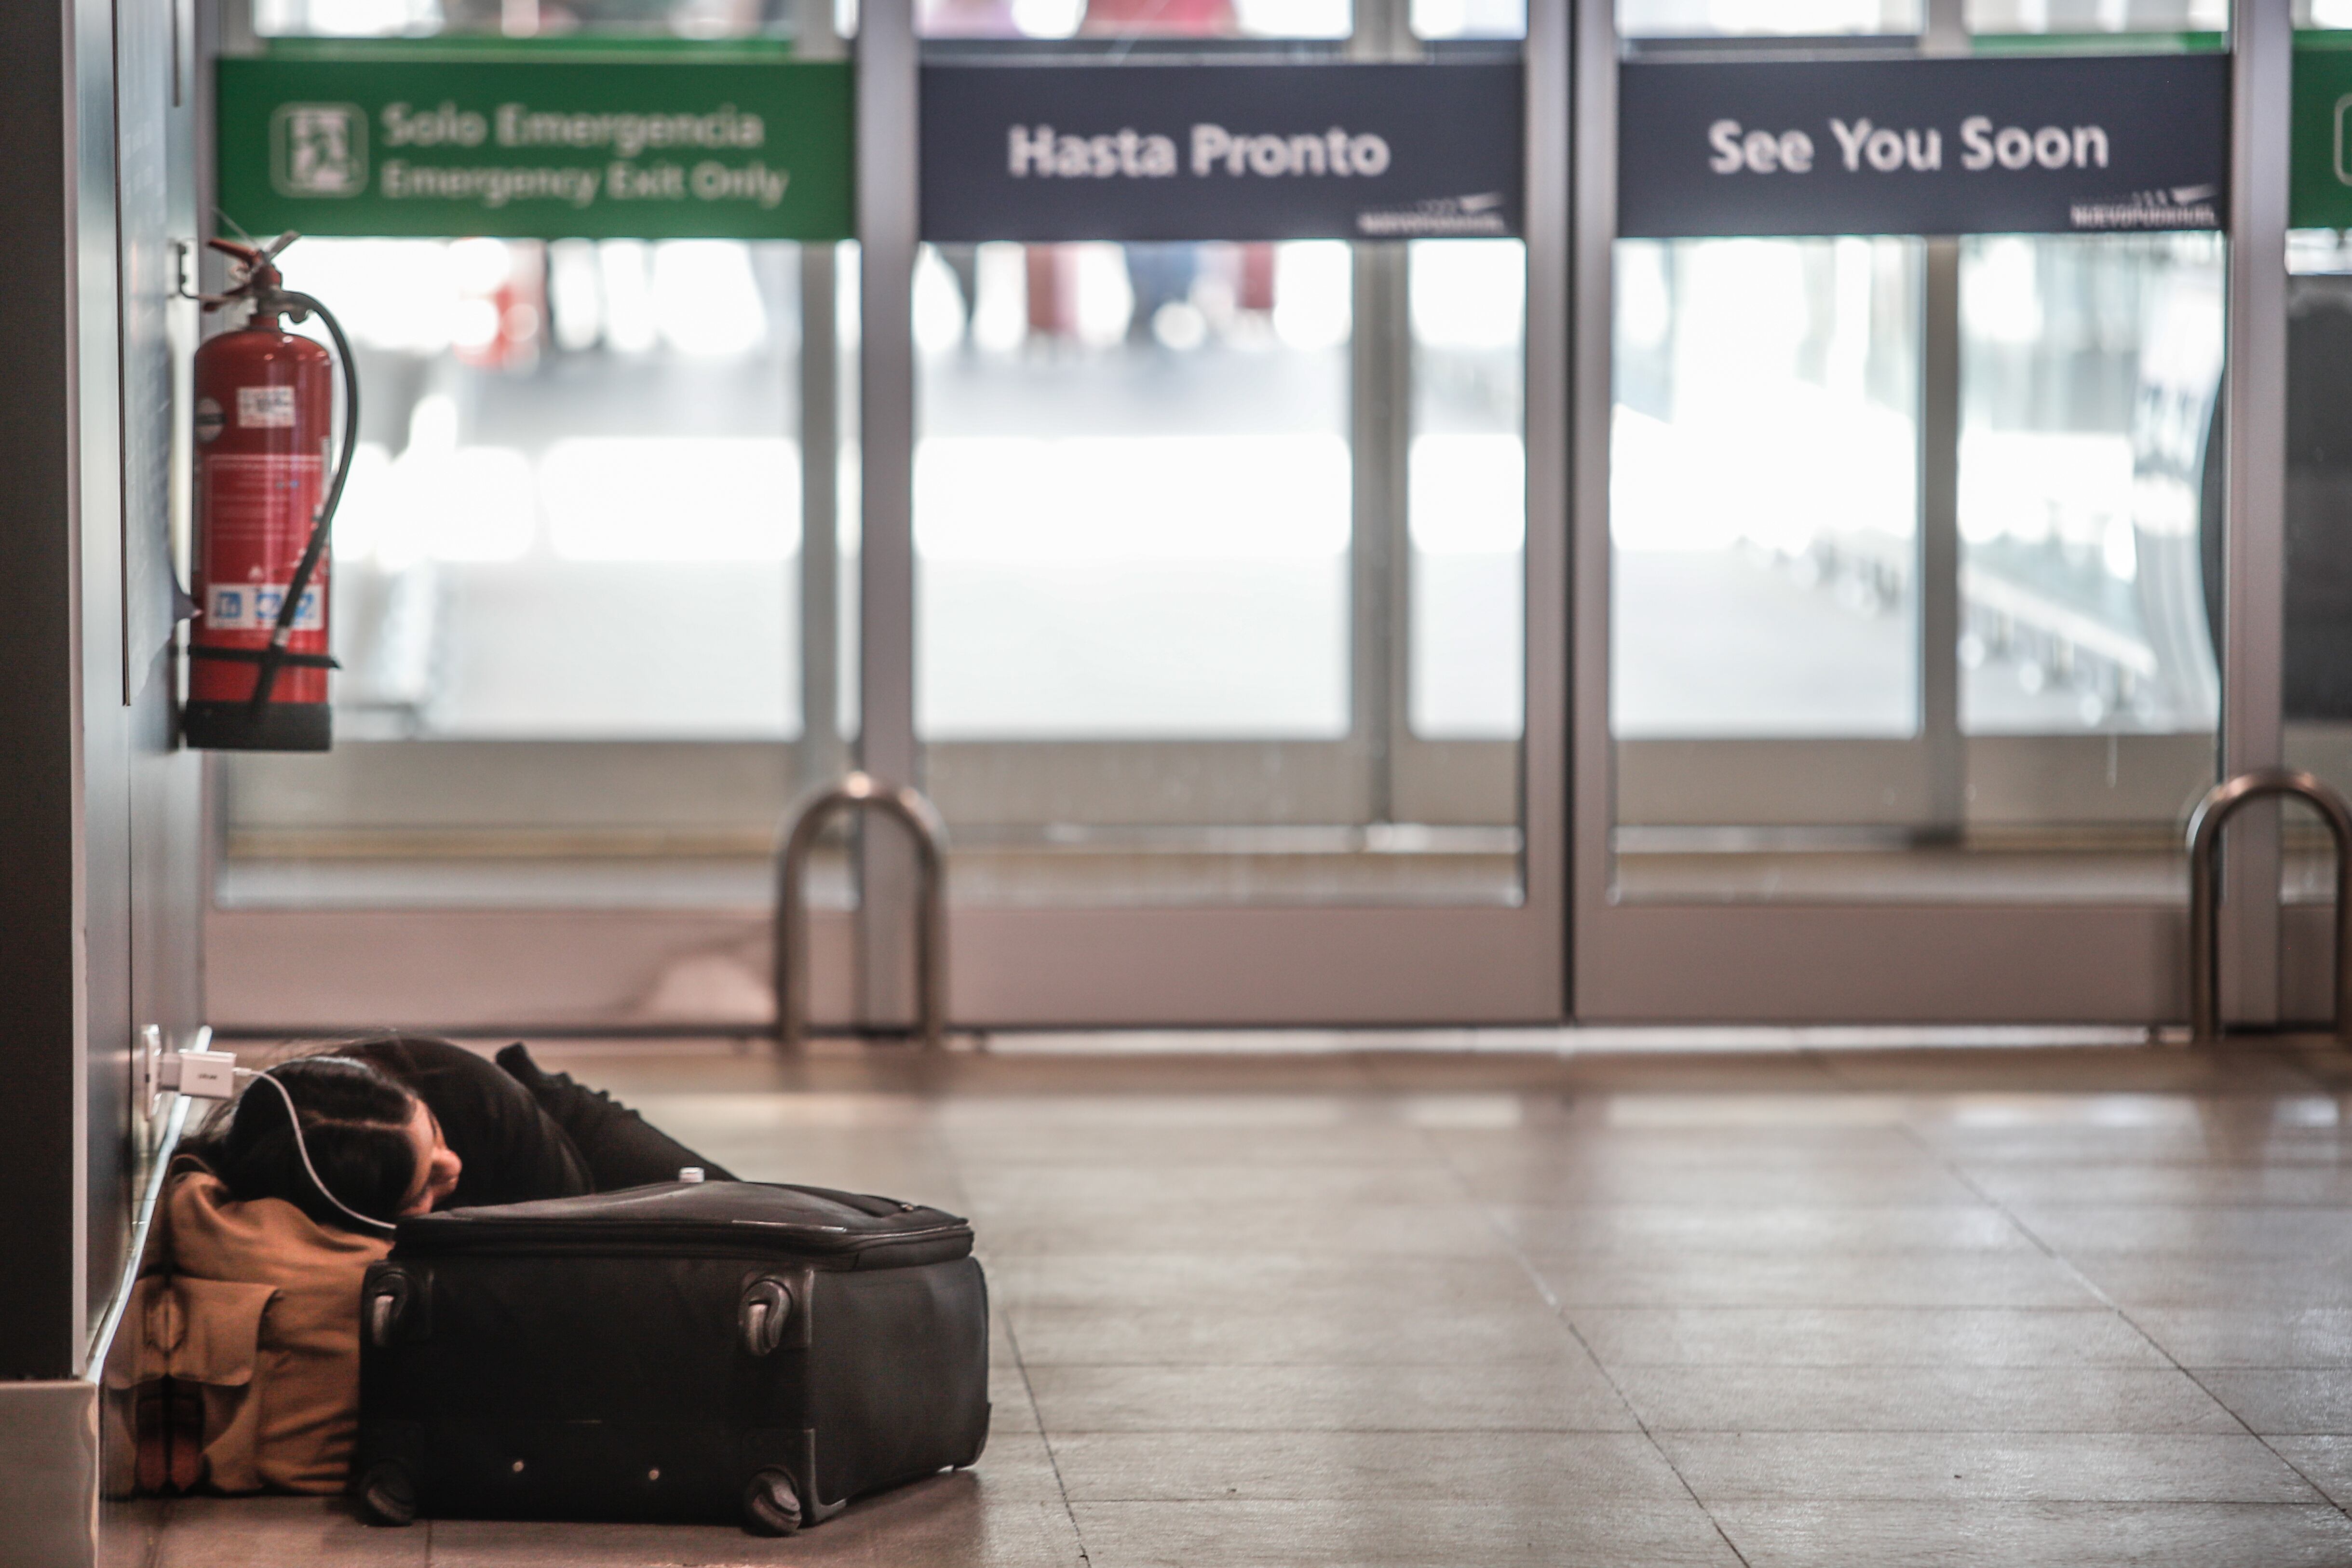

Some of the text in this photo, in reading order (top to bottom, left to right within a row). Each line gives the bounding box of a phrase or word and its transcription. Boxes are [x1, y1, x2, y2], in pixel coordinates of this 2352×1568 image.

[382, 102, 765, 157] Solo Emergencia
[1009, 123, 1391, 177] Hasta Pronto
[1708, 116, 2109, 174] See You Soon
[381, 160, 788, 208] Emergency Exit Only
